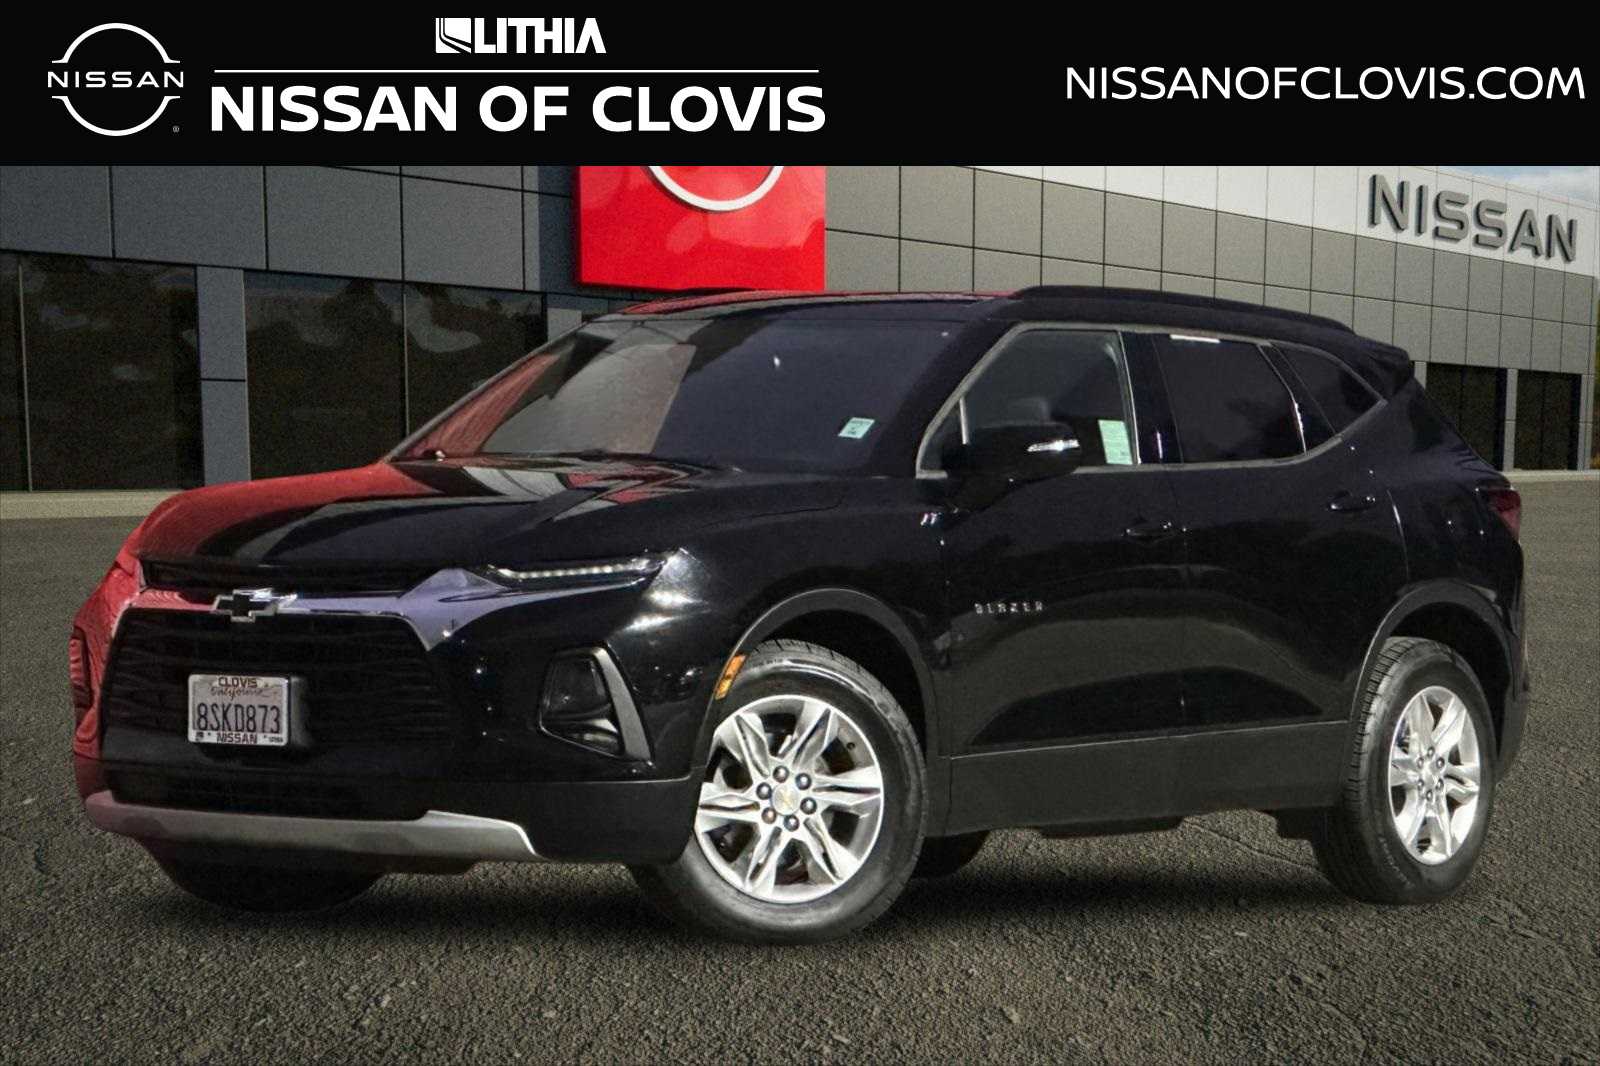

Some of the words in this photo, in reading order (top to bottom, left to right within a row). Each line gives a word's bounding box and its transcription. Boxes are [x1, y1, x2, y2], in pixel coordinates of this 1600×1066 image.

[1368, 173, 1577, 263] NISSAN
[196, 702, 281, 734] 8SKD873
[216, 731, 258, 745] NISSAN
